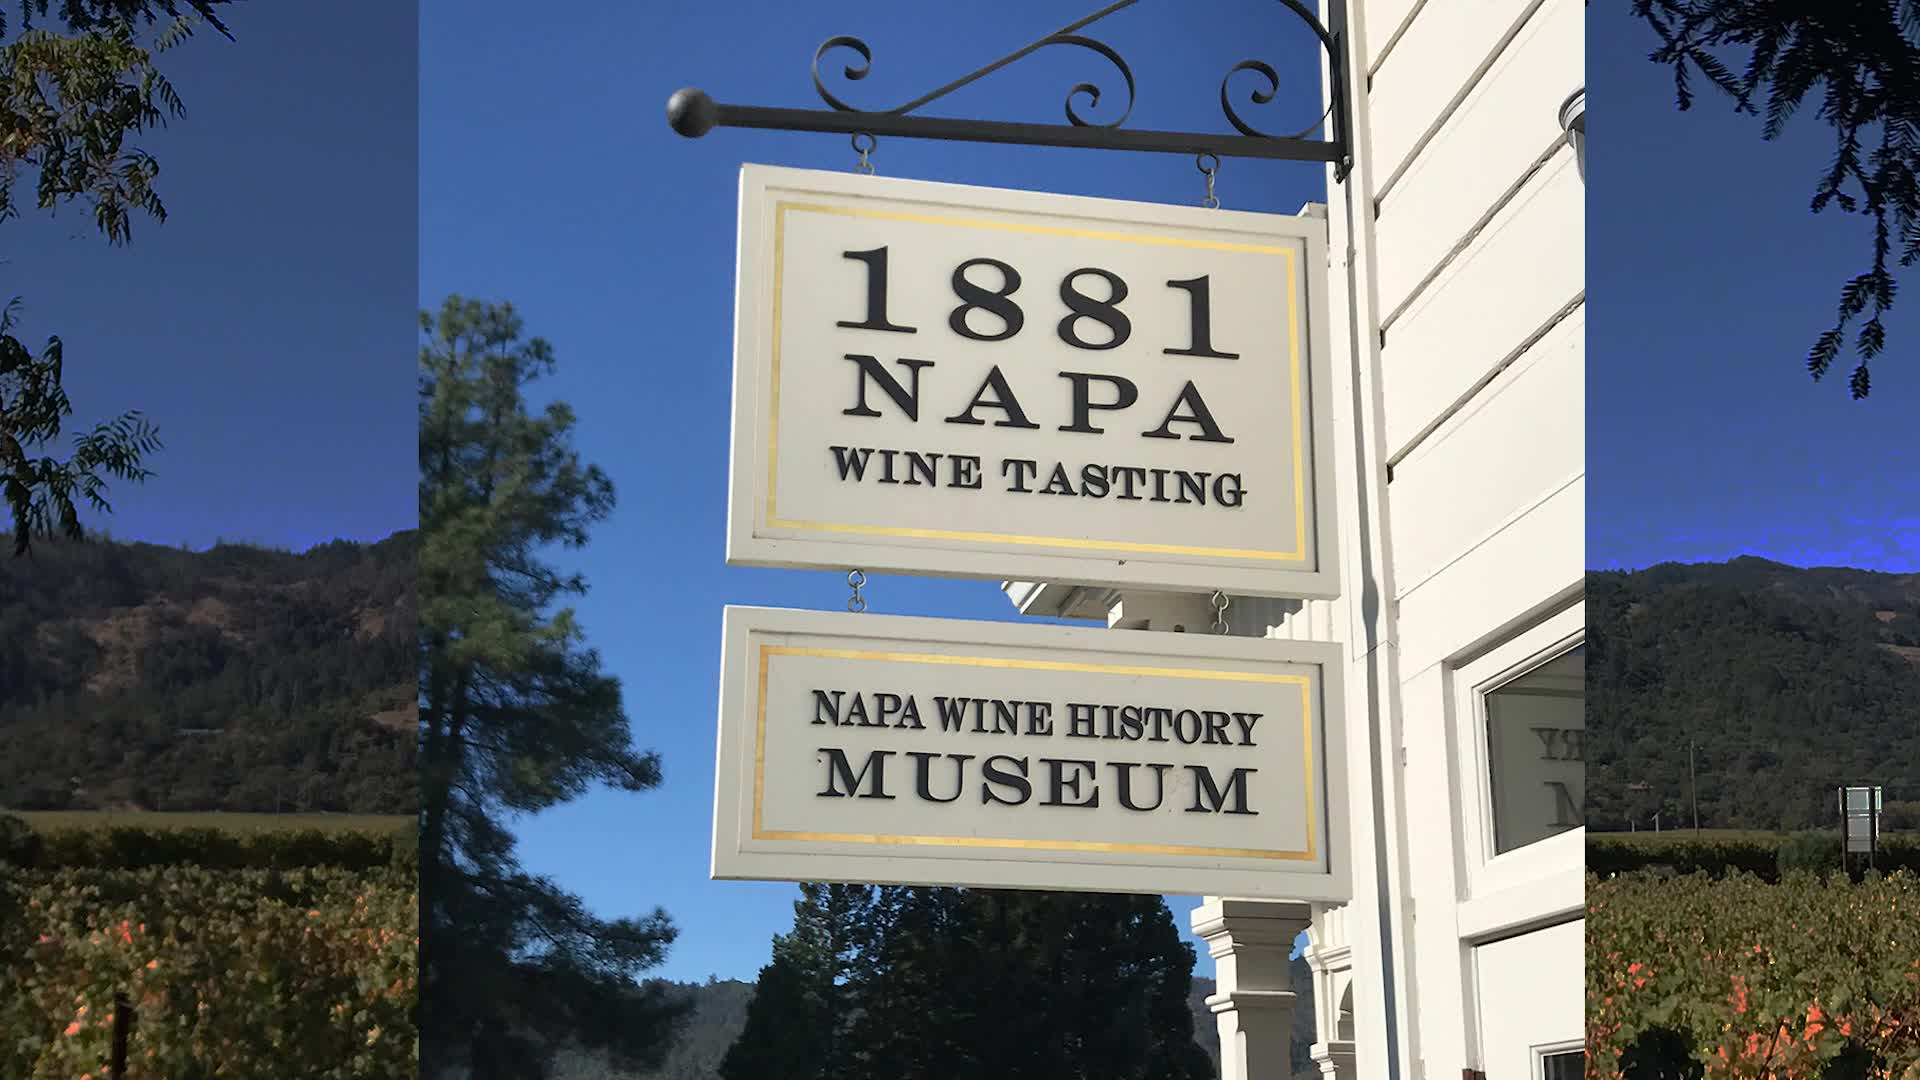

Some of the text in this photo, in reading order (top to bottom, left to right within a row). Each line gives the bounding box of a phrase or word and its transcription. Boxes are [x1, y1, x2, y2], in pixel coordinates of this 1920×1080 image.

[836, 245, 1240, 361] 1881
[842, 353, 1236, 445] NAPA
[829, 445, 1248, 508] WINE TASTING
[811, 689, 1265, 747] NAPA WINE HISTORY
[816, 747, 1260, 816] MUSEUM
